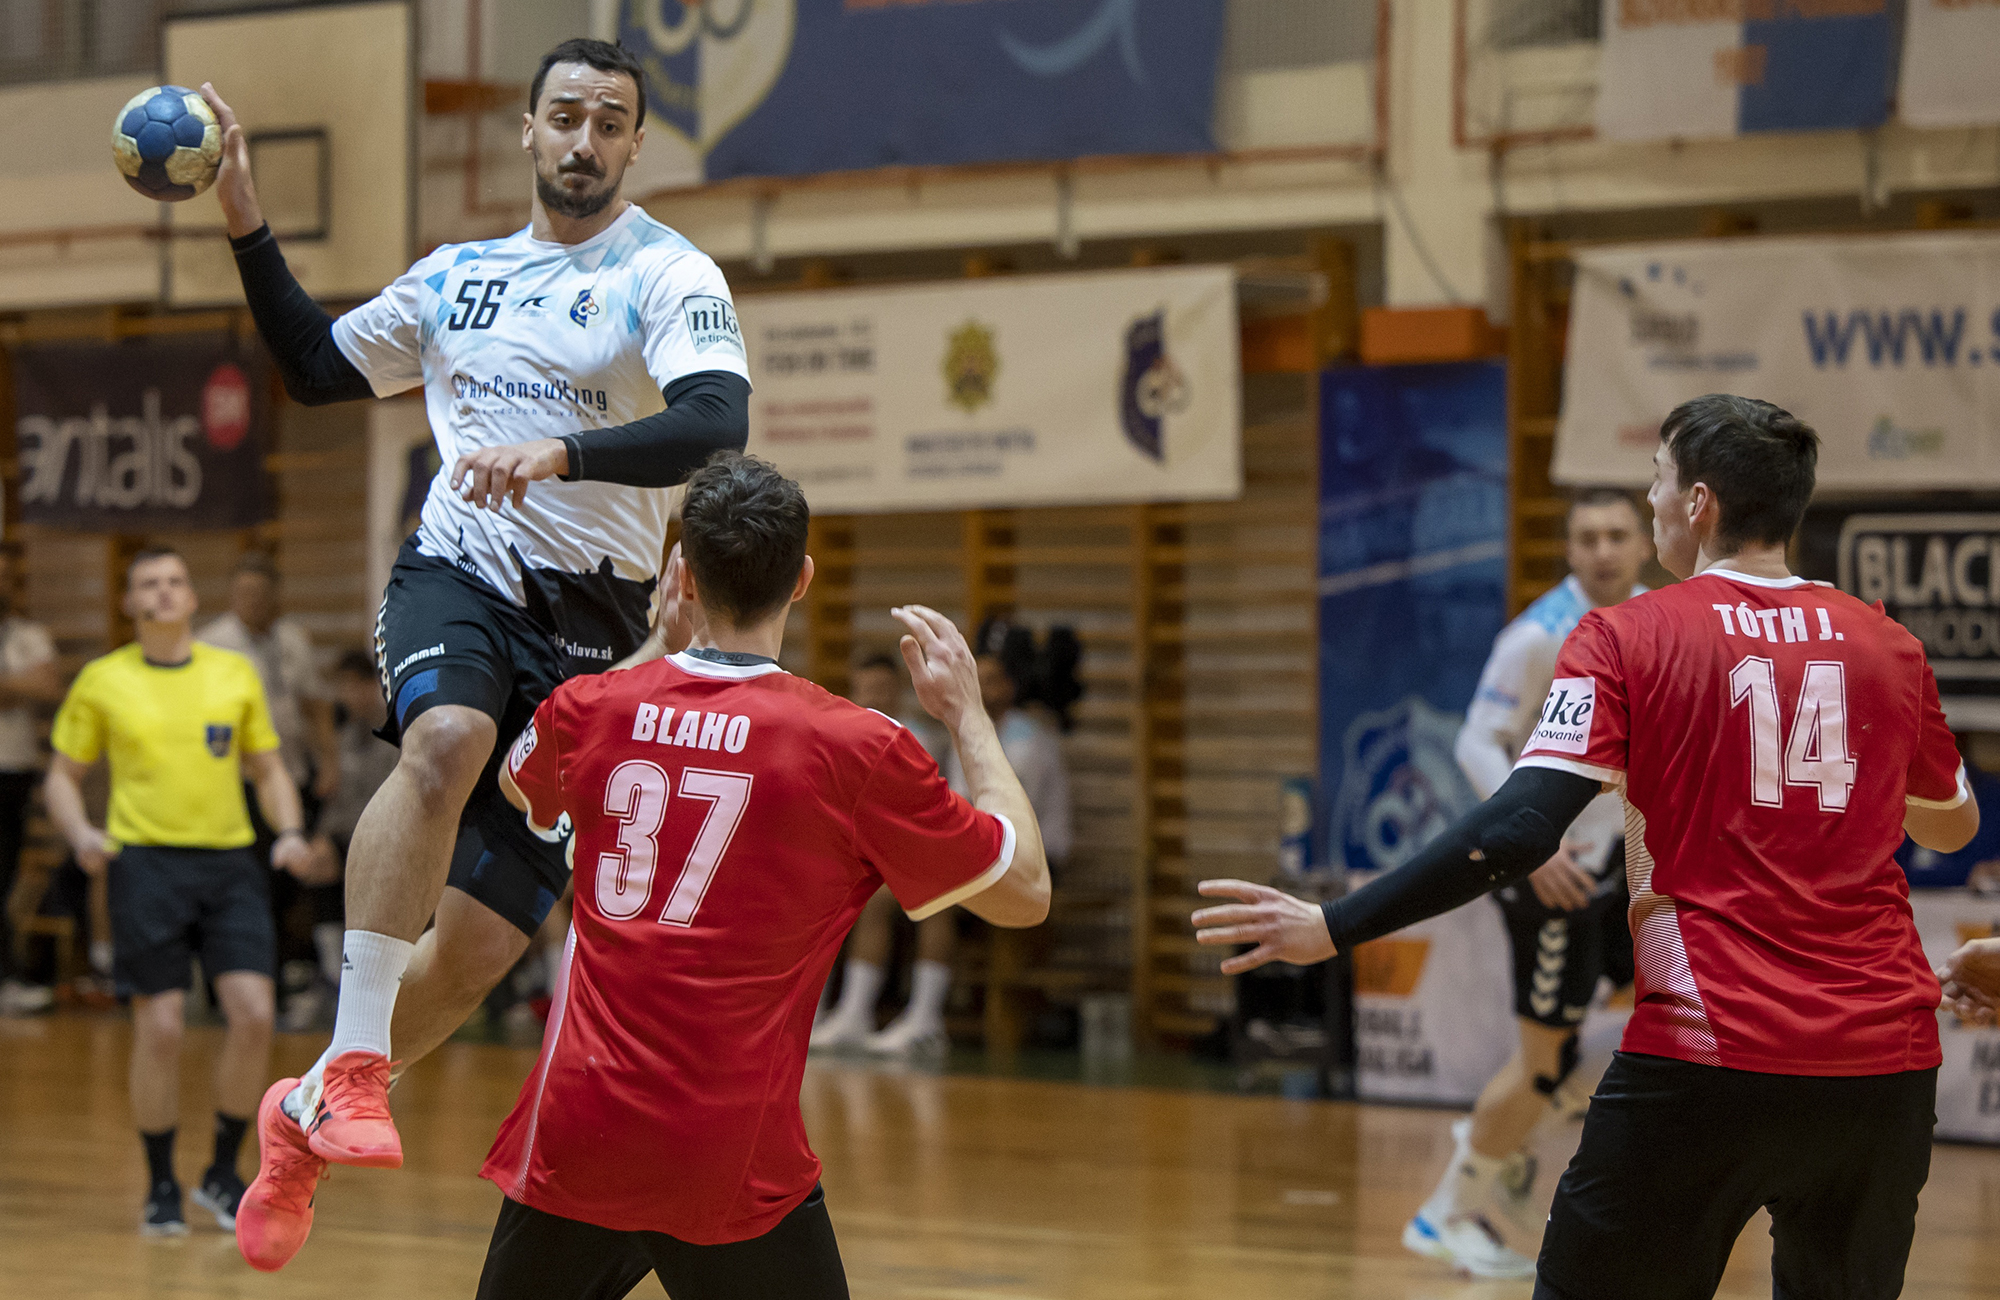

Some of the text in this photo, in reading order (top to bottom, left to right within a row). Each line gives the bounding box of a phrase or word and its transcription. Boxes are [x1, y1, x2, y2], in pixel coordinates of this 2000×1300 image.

[449, 280, 509, 330] 56
[1857, 535, 2000, 606] BLAC
[1712, 601, 1845, 643] TÓTH J.
[393, 642, 446, 677] hummel
[631, 702, 751, 754] BLAHO
[1728, 655, 1857, 813] 14
[594, 759, 754, 929] 37
